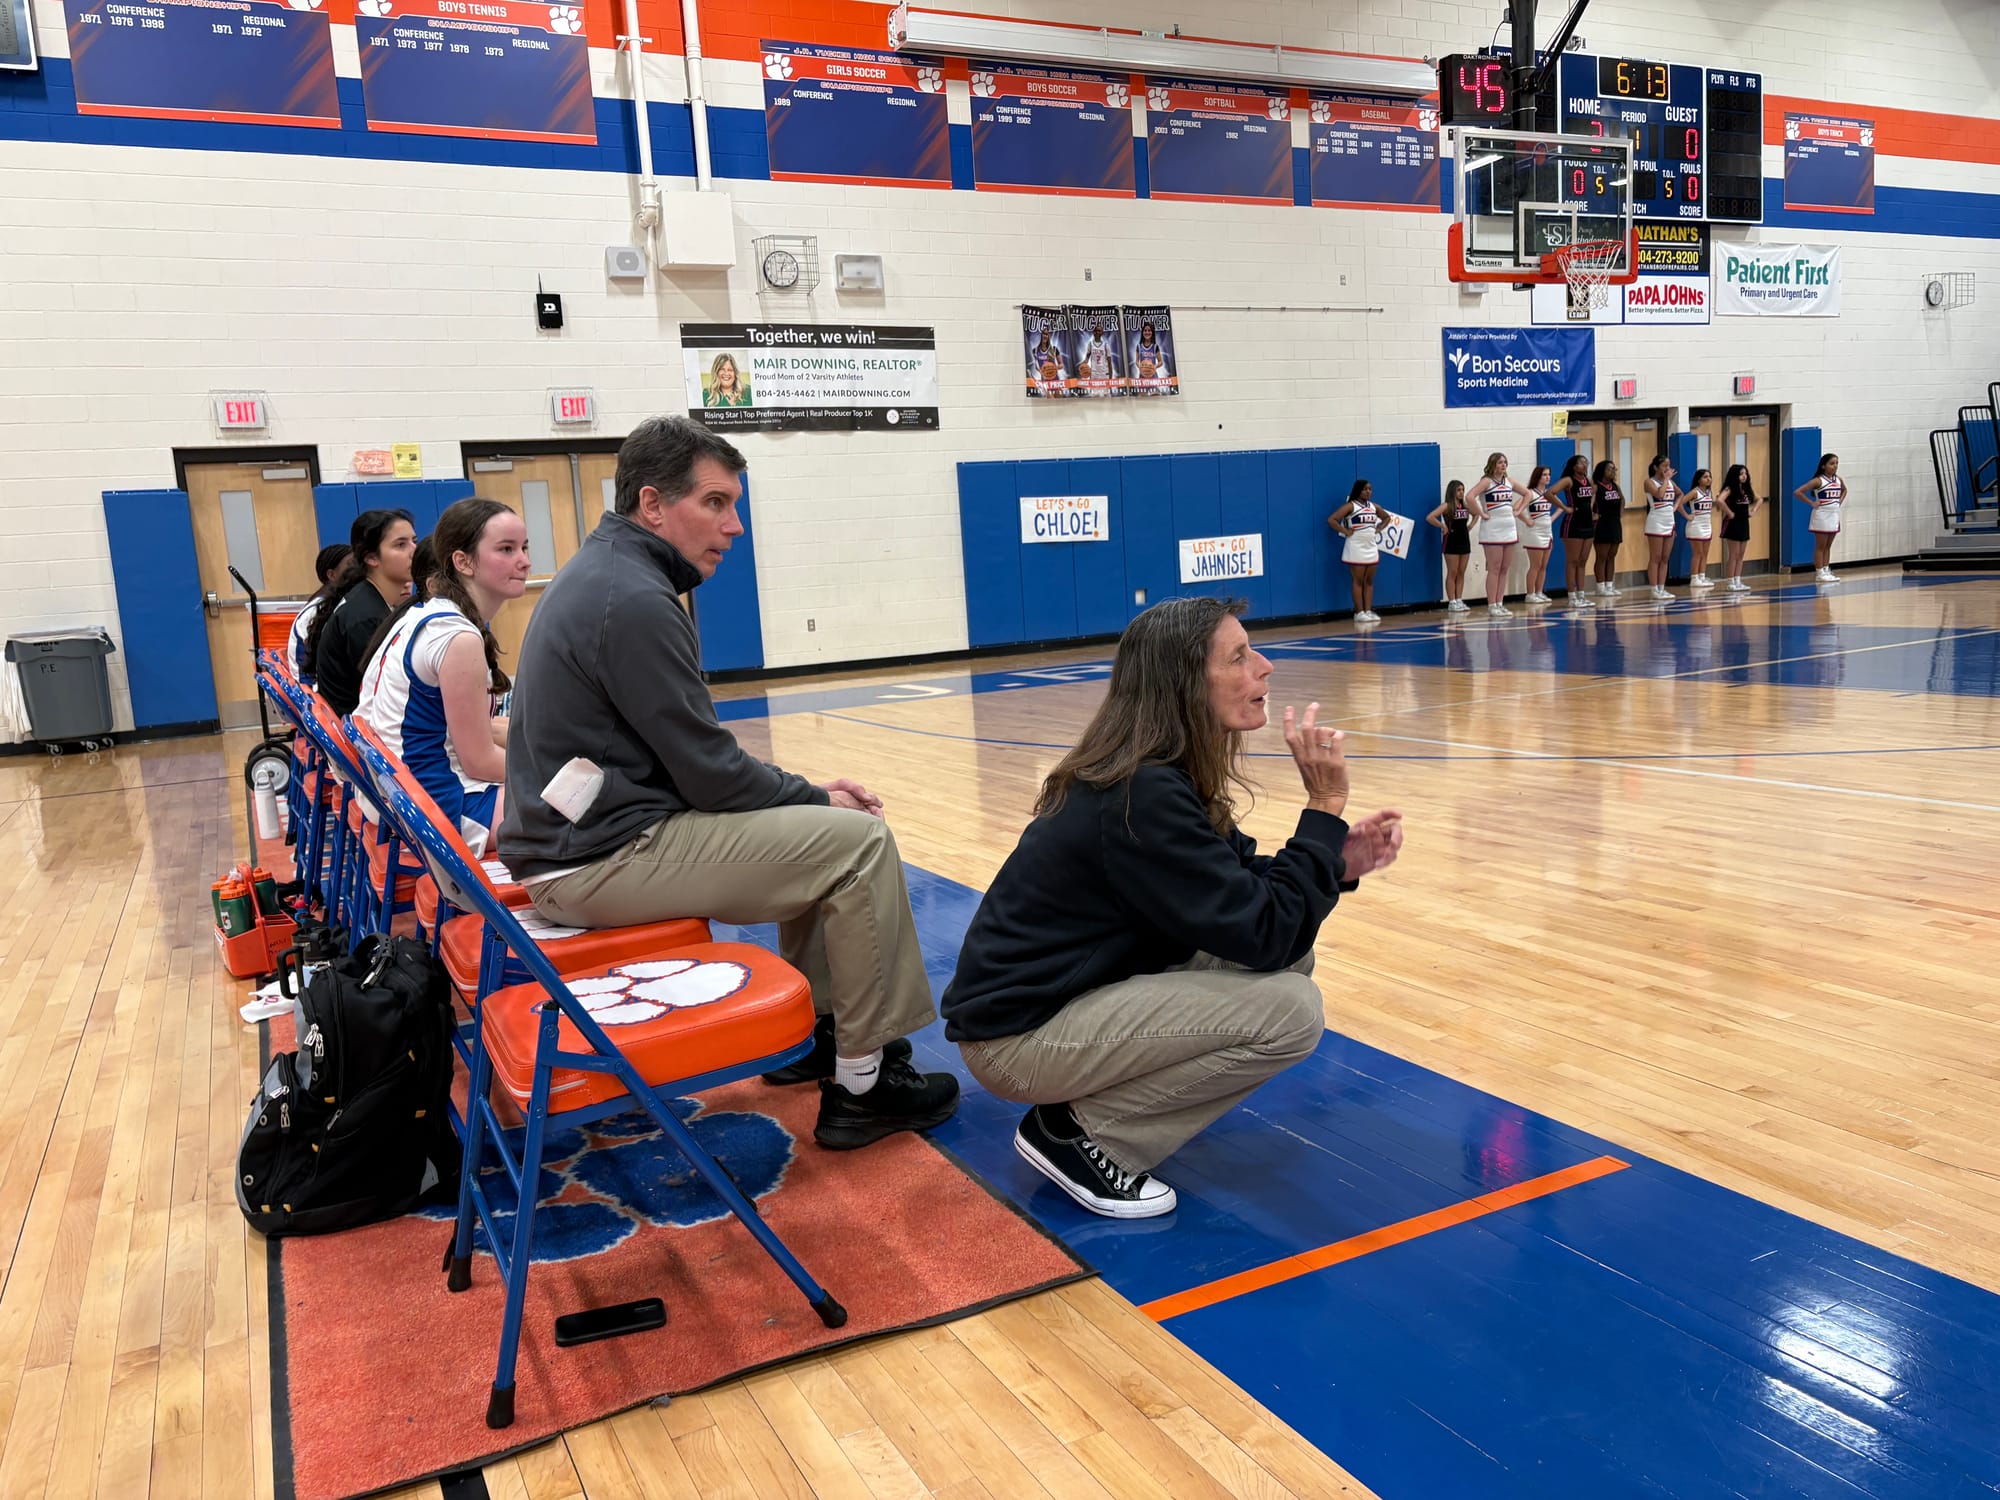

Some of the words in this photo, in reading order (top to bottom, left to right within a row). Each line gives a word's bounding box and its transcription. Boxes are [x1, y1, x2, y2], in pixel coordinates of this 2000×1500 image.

[106, 4, 165, 17] CONFERENCE
[438, 1, 466, 13] BOYS
[468, 4, 507, 18] TENNIS
[80, 13, 102, 24] 1971
[243, 15, 286, 28] REGIONAL
[212, 24, 233, 35] 1971
[393, 28, 444, 40] CONFERENCE
[369, 36, 390, 47] 1971
[396, 39, 417, 49] 1973
[424, 41, 443, 51] 1977
[512, 38, 550, 50] REGIONAL
[826, 64, 852, 76] GIRLS
[853, 66, 887, 79] SOCCER
[1616, 62, 1667, 98] 6:13
[1711, 73, 1725, 85] PLYR
[1729, 75, 1740, 86] FLS
[1746, 77, 1756, 88] PTS
[793, 89, 833, 100] CONFERENCE
[1027, 82, 1047, 93] BOYS
[1048, 84, 1077, 95] SOCCER
[1460, 64, 1505, 112] 45
[886, 97, 917, 107] REGIONAL
[1203, 97, 1236, 109] SOFTBALL
[1569, 97, 1601, 115] HOME
[996, 105, 1032, 116] CONFERENCE
[1078, 112, 1106, 121] REGIONAL
[1361, 109, 1391, 120] BASEBALL
[1621, 110, 1647, 123] PERIOD
[1665, 105, 1699, 123] GUEST
[1169, 119, 1202, 129] CONFERENCE
[1685, 128, 1699, 160] 0
[1640, 160, 1659, 172] FOUL
[1679, 162, 1702, 174] FOULS
[1573, 169, 1585, 195] 0
[1687, 175, 1699, 200] 0
[1679, 205, 1702, 216] SCORE
[1635, 225, 1699, 242] NATHAN'S
[1726, 256, 1790, 284] Patient
[1795, 259, 1829, 286] First
[1628, 284, 1661, 305] PAPA
[1662, 284, 1704, 306] JOHNS
[1740, 286, 1767, 300] Primary
[1767, 288, 1780, 298] and
[1781, 287, 1802, 300] Urgent
[1803, 288, 1818, 299] Care
[746, 328, 818, 345] Together,
[821, 333, 842, 344] we
[844, 329, 876, 344] win!
[753, 358, 788, 370] MAIR
[791, 358, 860, 371] DOWNING,
[1472, 355, 1501, 373] Bon
[1504, 355, 1561, 373] Secours
[754, 373, 776, 381] Proud
[777, 373, 795, 381] Mom
[796, 373, 804, 381] of
[811, 373, 836, 382] Varsity
[836, 373, 864, 381] Athletes
[1457, 377, 1487, 389] Sports
[1489, 376, 1529, 387] Medicine
[756, 389, 815, 398] 804-245-4462
[823, 389, 911, 398] MAIRDOWNING.COM
[225, 401, 257, 424] EXIT
[561, 397, 587, 417] EXIT
[704, 411, 724, 420] Rising
[725, 411, 739, 419] Star
[743, 411, 755, 419] Top
[756, 409, 785, 418] Preferred
[786, 410, 805, 419] Agent
[809, 409, 823, 417] Real
[824, 409, 852, 417] Producer
[853, 410, 863, 418] Top
[1035, 498, 1064, 511] LET'S
[1077, 498, 1090, 510] GO
[1034, 510, 1099, 538] CHLOE!
[1231, 537, 1246, 551] GO
[1191, 550, 1253, 576] JAHNISE!
